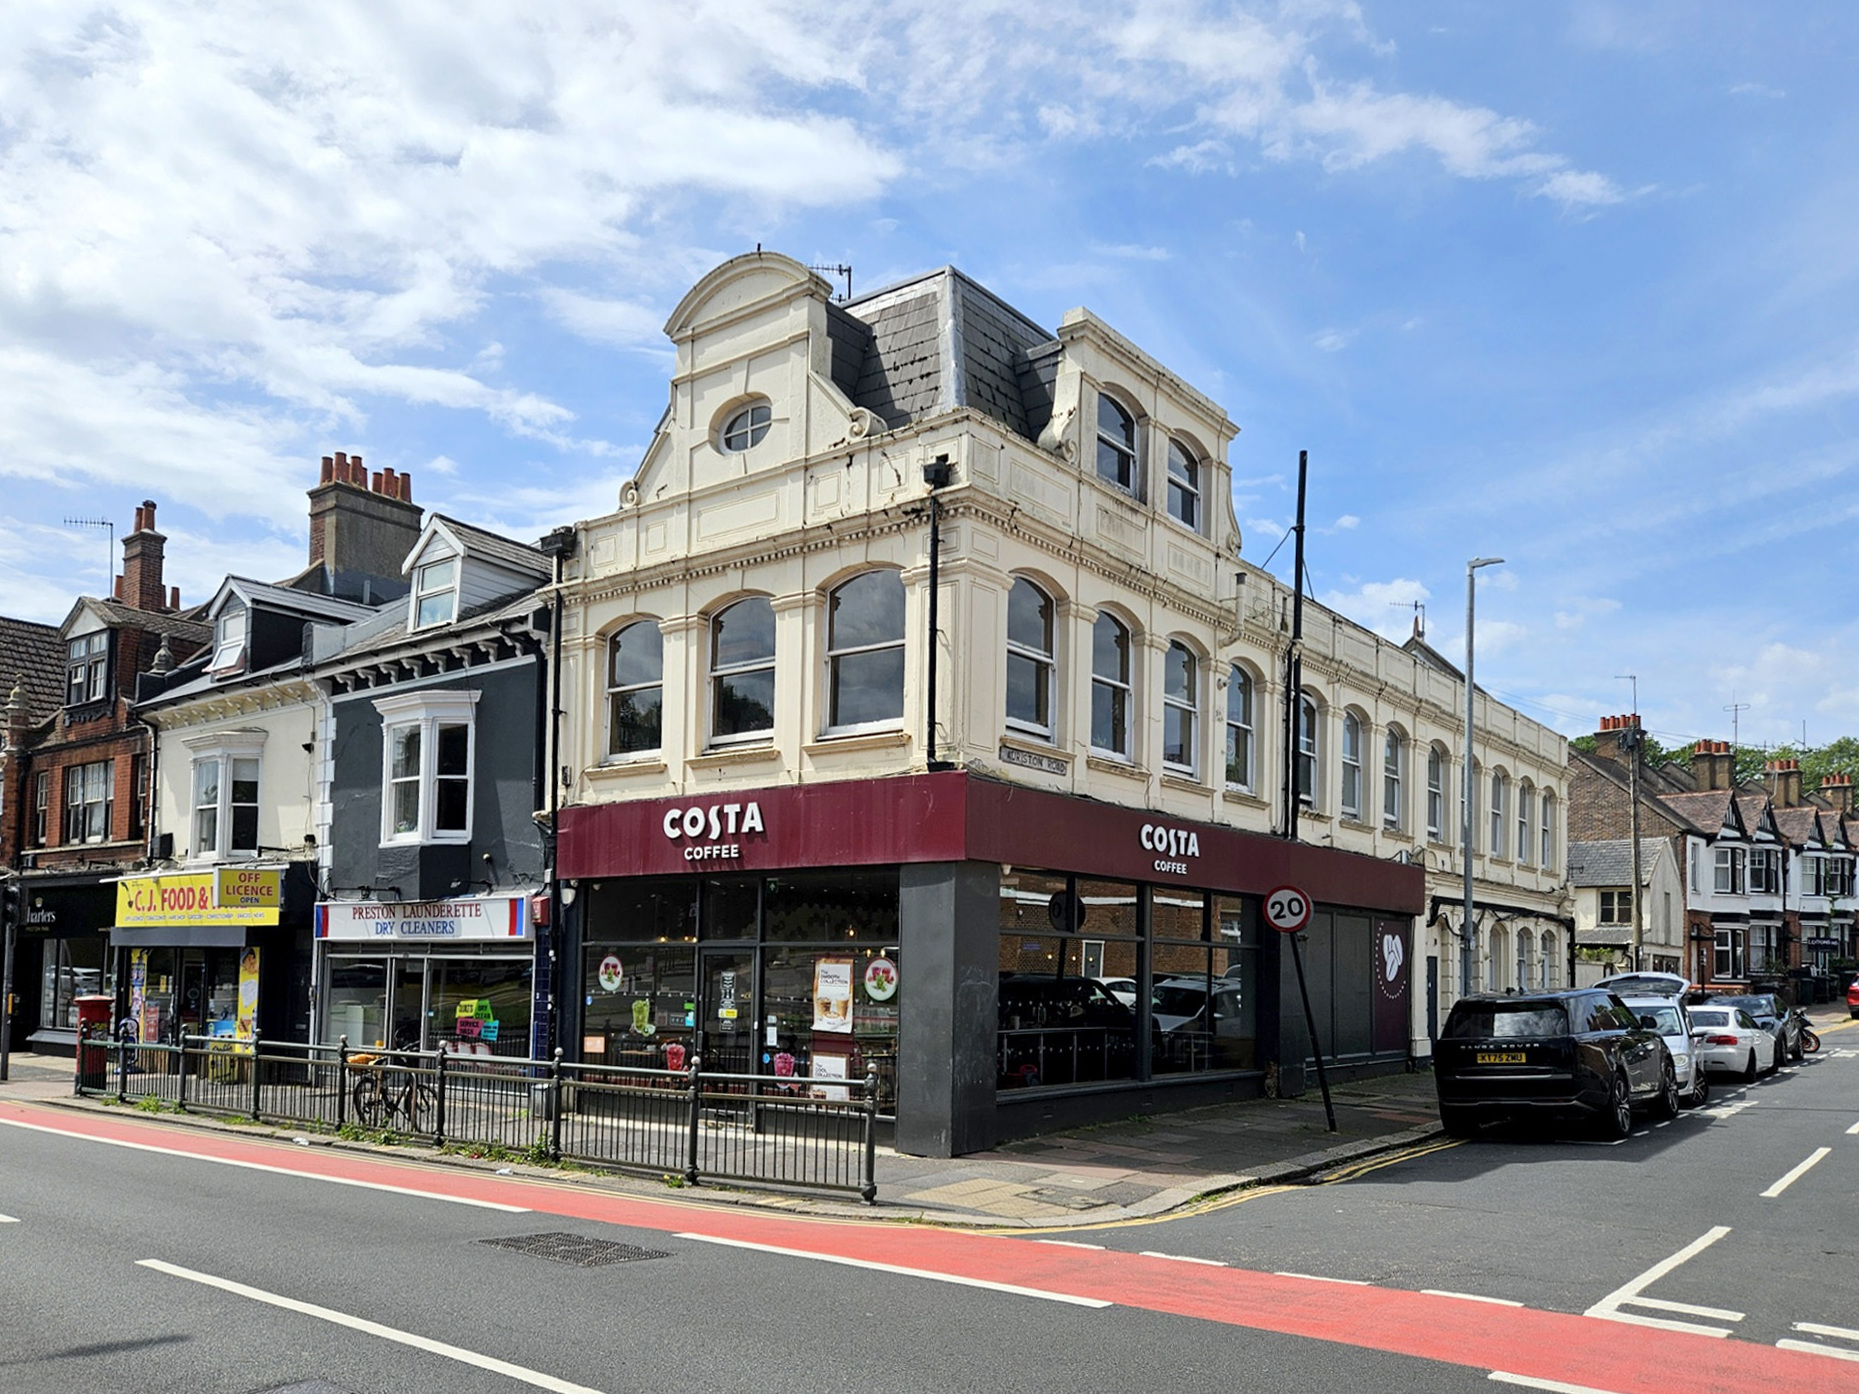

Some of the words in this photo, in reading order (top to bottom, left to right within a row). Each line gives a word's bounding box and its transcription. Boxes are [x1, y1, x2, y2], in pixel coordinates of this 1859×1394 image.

[1047, 759, 1066, 772] ROAD
[663, 802, 764, 840] COSTA
[1141, 823, 1200, 857] COSTA
[684, 844, 740, 861] COFFEE
[1154, 859, 1188, 875] COFFEE
[238, 872, 261, 883] OFF
[161, 886, 196, 911] FOOD
[199, 886, 208, 910] &
[226, 885, 273, 896] LICENCE
[352, 905, 396, 920] PRESTON
[403, 903, 482, 918] LAUNDERETTE
[1270, 897, 1304, 920] 20
[375, 921, 395, 935] DRY
[400, 920, 455, 935] CLEANERS
